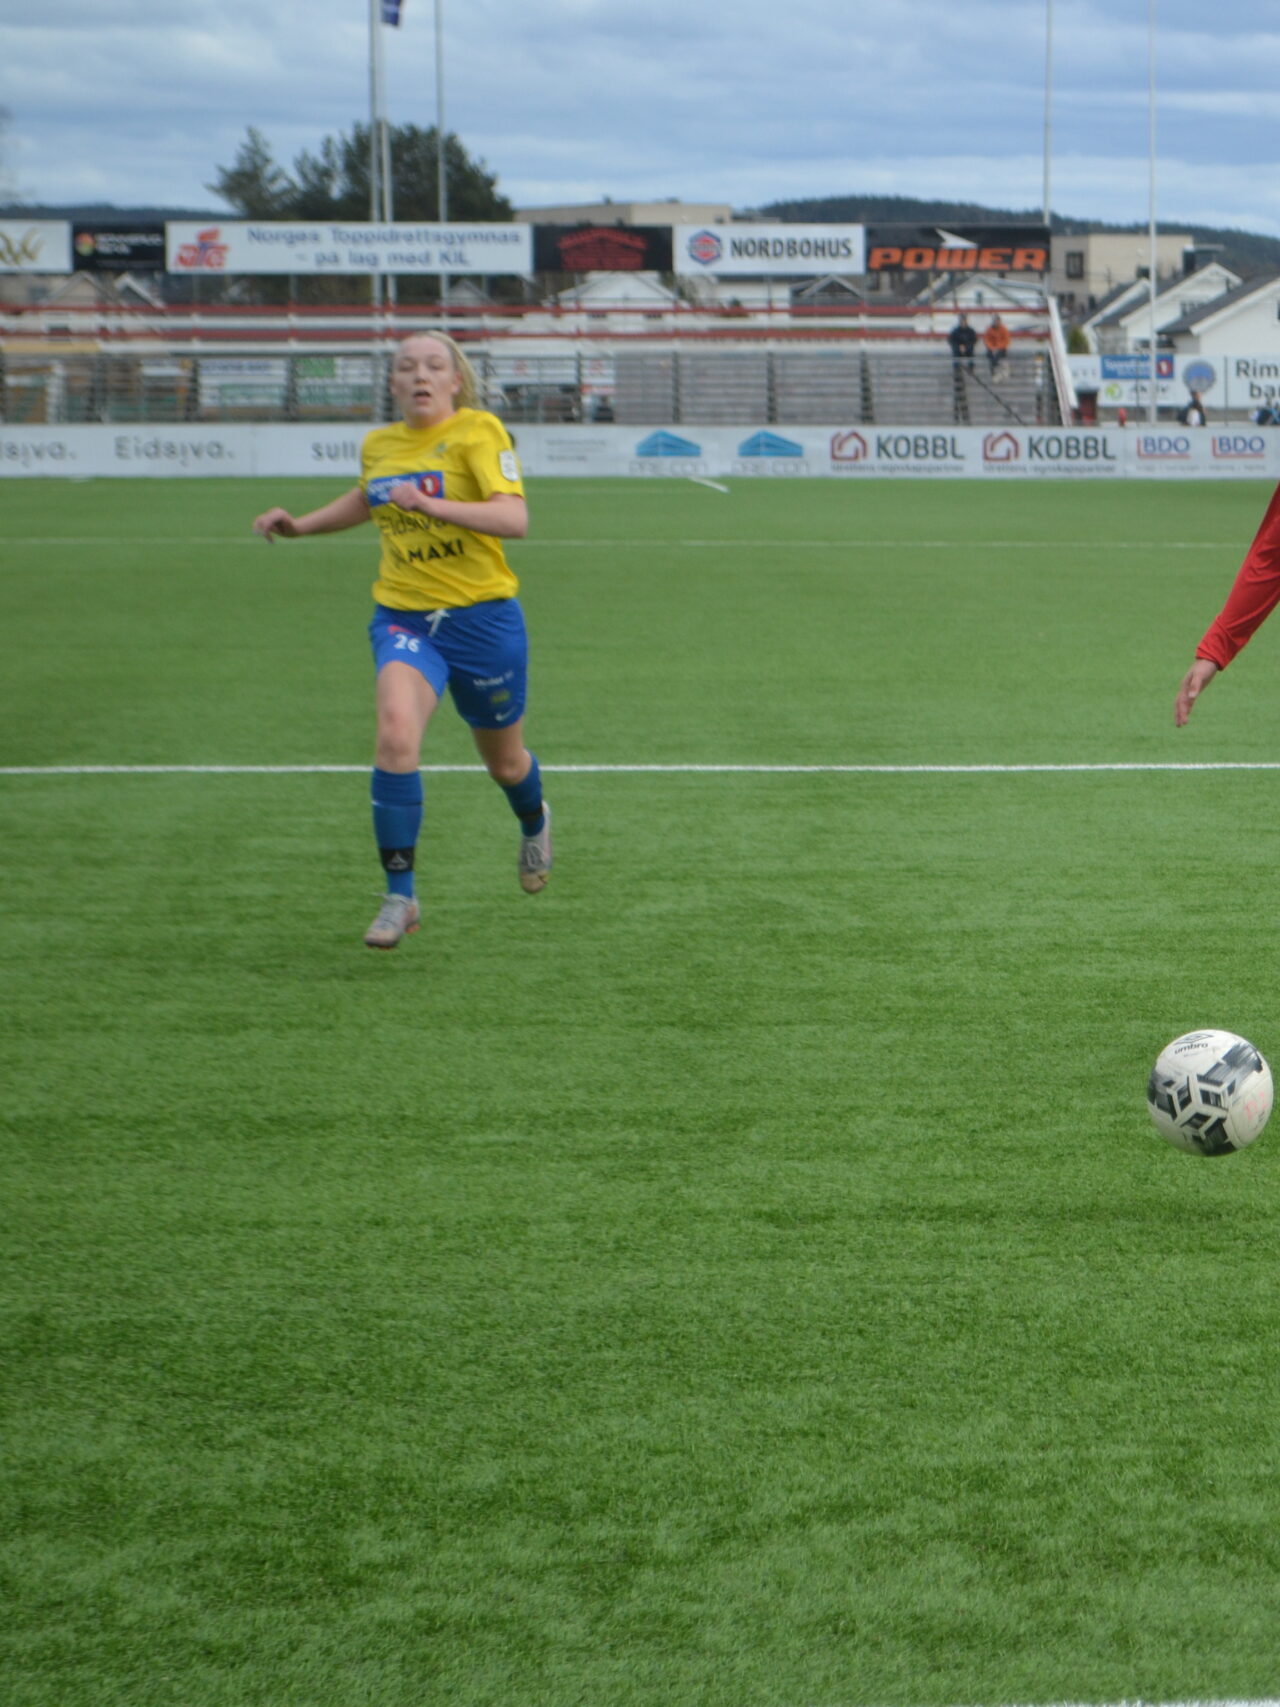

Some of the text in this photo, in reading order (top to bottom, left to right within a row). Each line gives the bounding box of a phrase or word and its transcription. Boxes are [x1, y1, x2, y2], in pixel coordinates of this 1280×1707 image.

[247, 227, 520, 247] Norges Toppidrettsgymnas
[730, 237, 852, 259] NORDBOHUS
[315, 250, 339, 266] på
[348, 250, 378, 267] lag
[387, 250, 430, 264] med
[439, 252, 470, 265] KIL
[868, 247, 1047, 270] POWER
[876, 435, 965, 459] KOBBL
[1028, 435, 1116, 459] KOBBL
[1143, 435, 1190, 453] BDO
[1218, 435, 1265, 453] BDO
[408, 538, 465, 563] MAXI
[393, 633, 421, 653] 26
[1175, 1042, 1208, 1054] umbro
